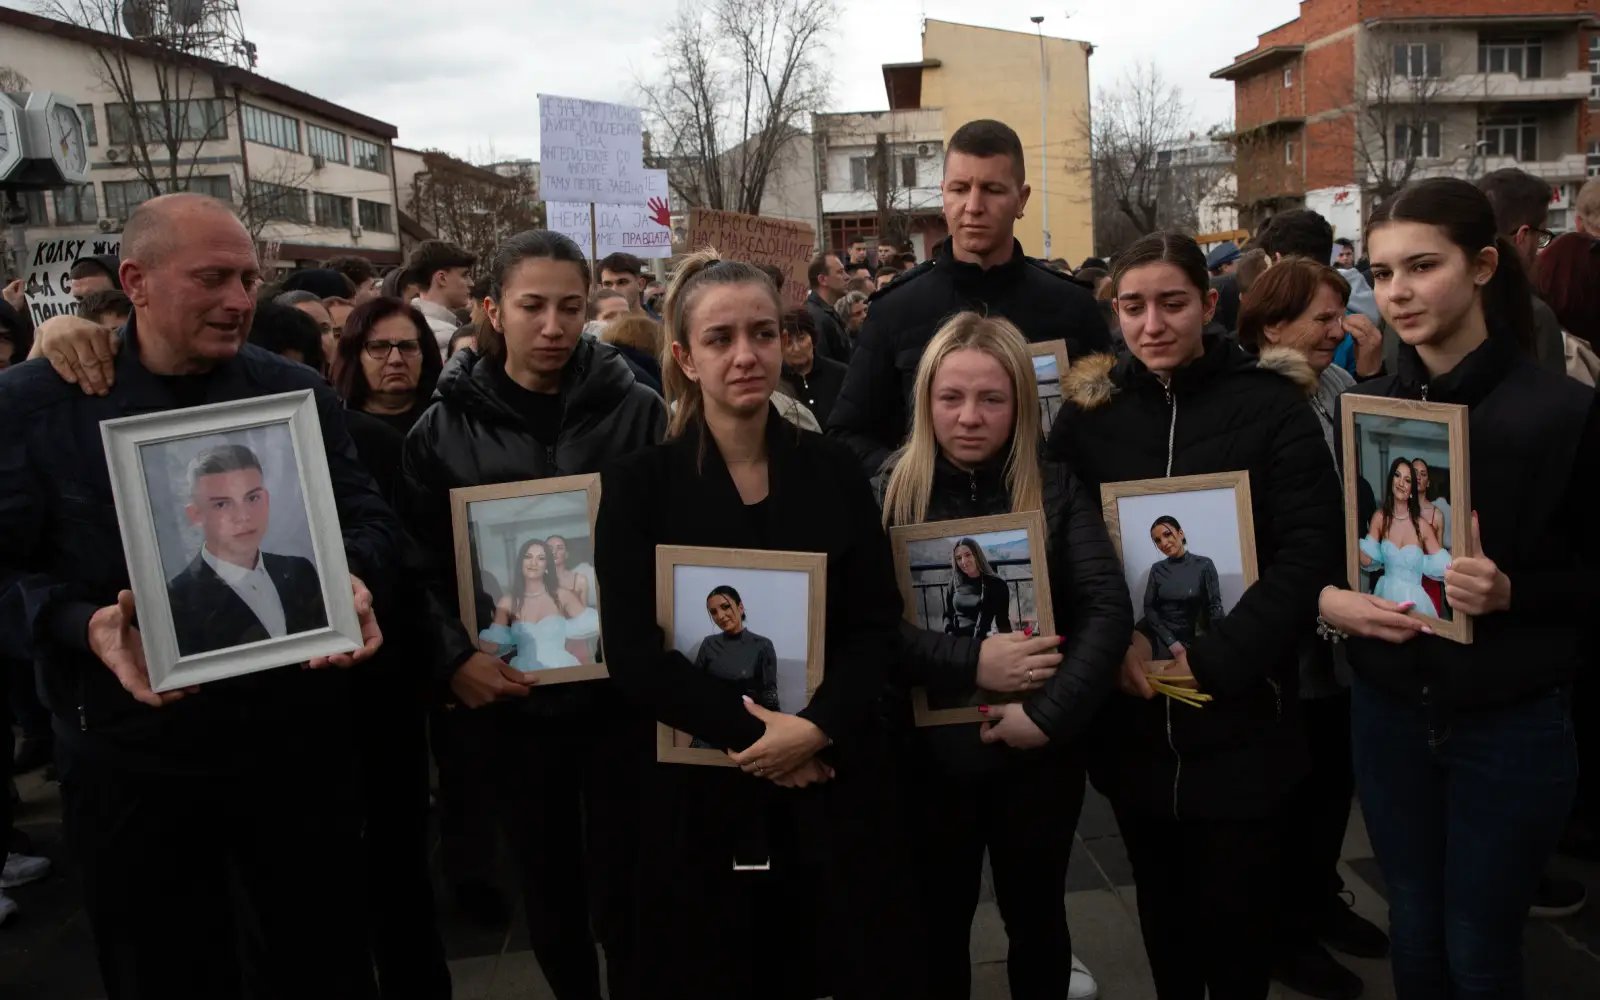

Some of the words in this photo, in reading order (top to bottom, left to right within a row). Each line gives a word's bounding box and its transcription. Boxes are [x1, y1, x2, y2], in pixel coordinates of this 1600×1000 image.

[545, 175, 570, 192] ТАМУ
[600, 212, 622, 229] ДА
[622, 231, 670, 245] ПРАВДАТА
[33, 240, 85, 266] КОЛКУ
[25, 272, 56, 299] ДА
